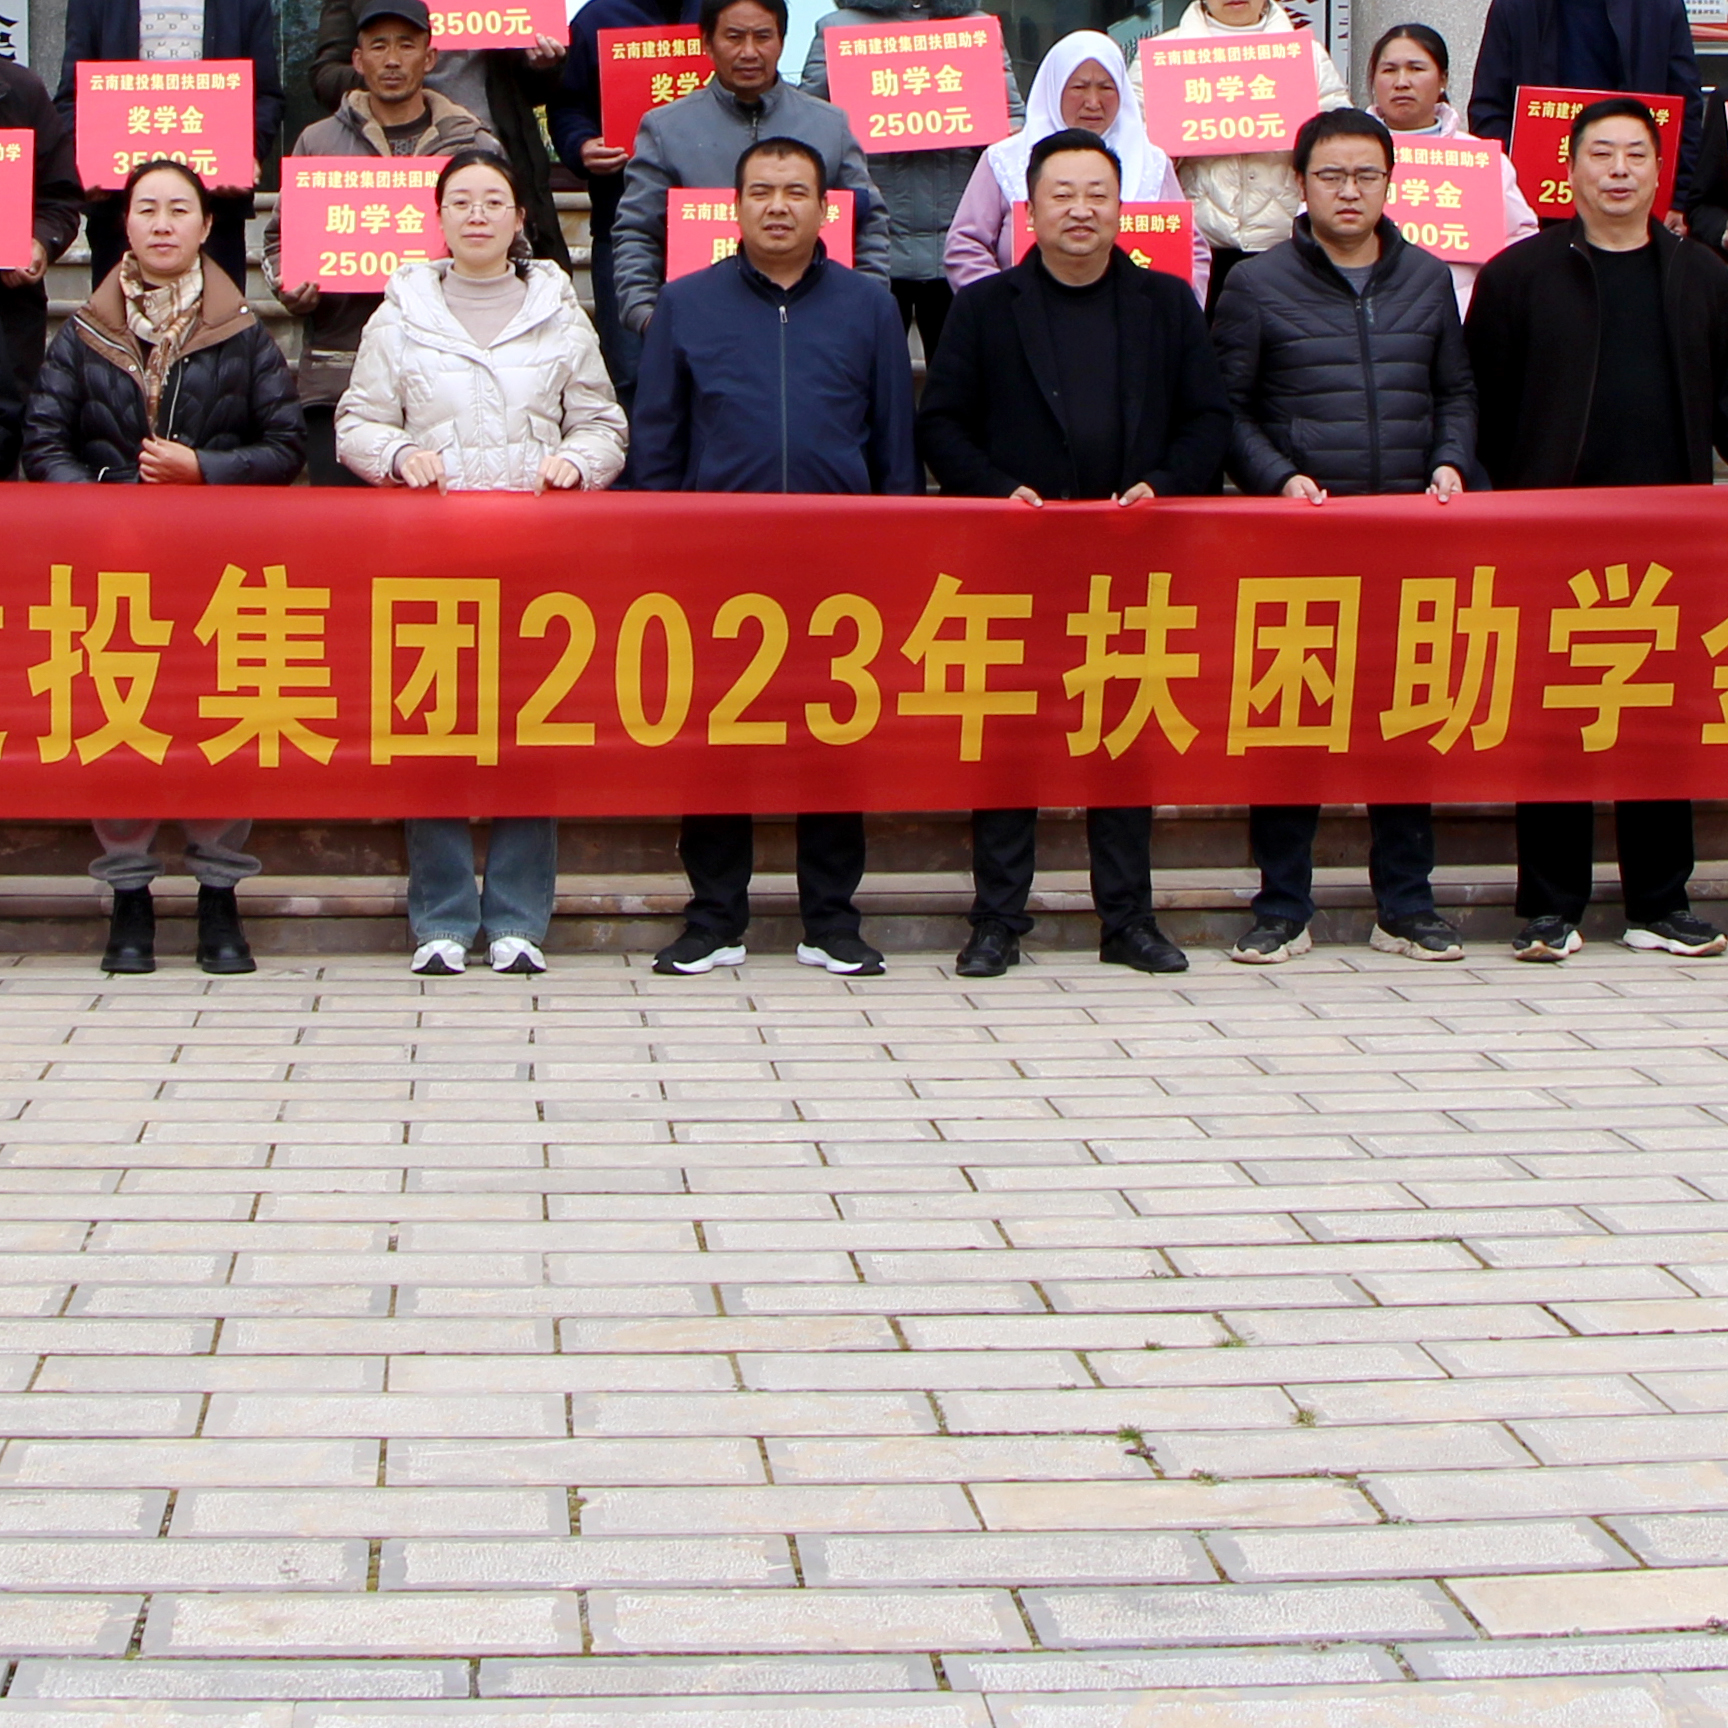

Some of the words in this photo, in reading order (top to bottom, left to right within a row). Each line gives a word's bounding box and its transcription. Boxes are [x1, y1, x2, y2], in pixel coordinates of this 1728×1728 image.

[431, 7, 533, 36] 3500元
[611, 37, 706, 60] 云南建投集团
[839, 29, 988, 57] 云南建投集团扶困助学
[1153, 40, 1301, 67] 云南建投集团扶困助学
[90, 73, 241, 91] 云南建投集团扶困助学
[871, 64, 964, 97] 助学金
[1184, 73, 1277, 104] 助学金
[127, 105, 204, 135] 奖学金
[869, 106, 973, 138] 2500元
[1182, 113, 1286, 142] 2500元
[327, 204, 425, 233] 助学金
